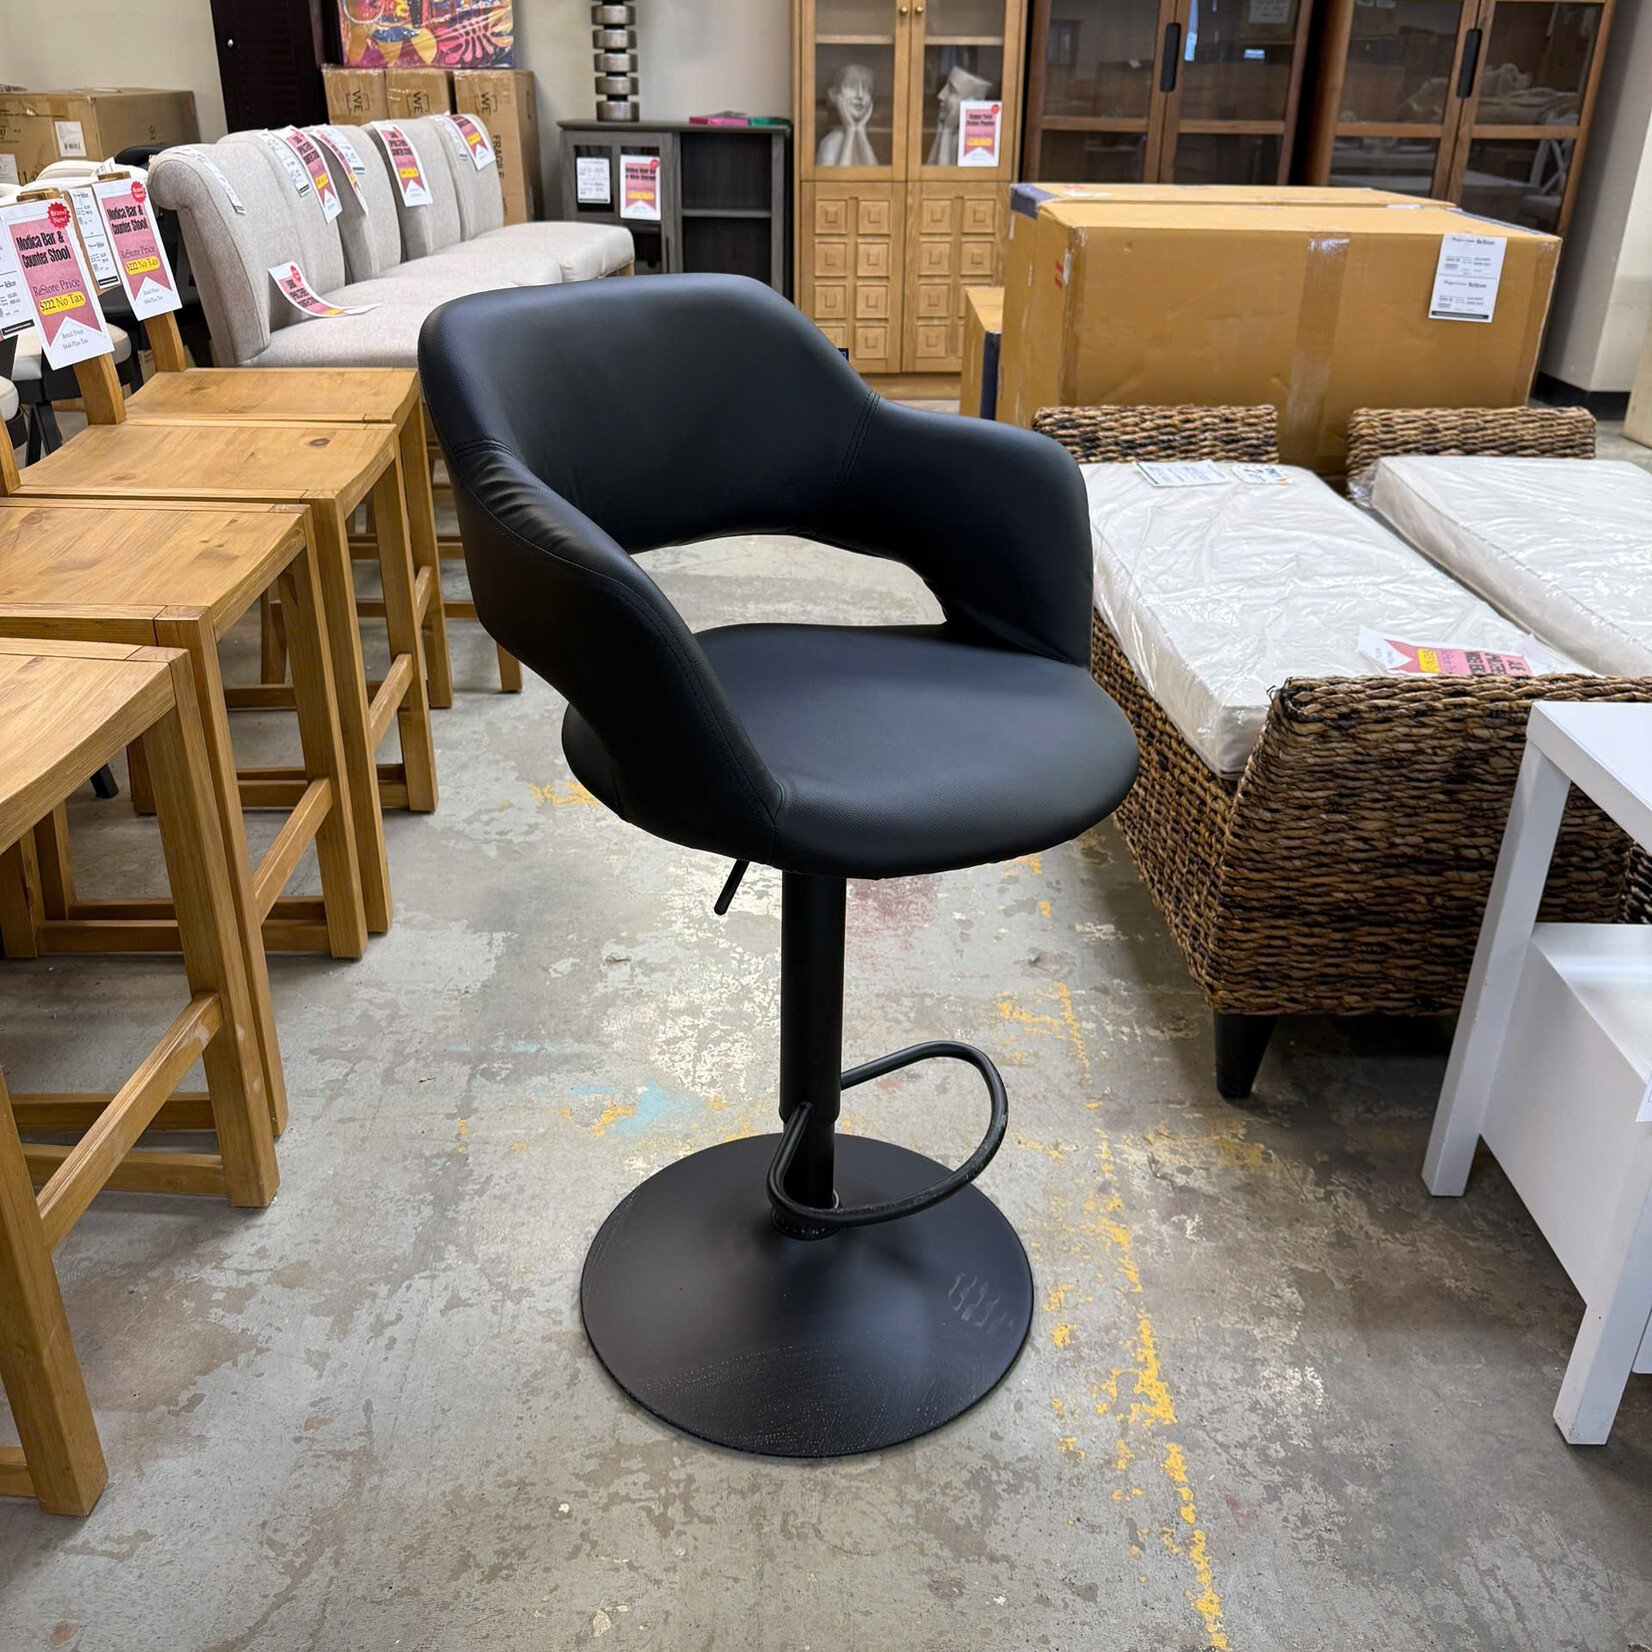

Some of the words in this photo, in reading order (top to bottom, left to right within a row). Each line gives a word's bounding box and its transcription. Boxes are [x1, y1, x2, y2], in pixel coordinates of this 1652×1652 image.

[351, 89, 364, 113] WE
[412, 90, 424, 114] WE
[480, 91, 492, 115] WE
[125, 206, 137, 217] Bar
[40, 232, 56, 246] Bar
[57, 230, 65, 243] &
[22, 251, 49, 268] Counter
[48, 245, 71, 262] Stool
[137, 260, 147, 269] No
[146, 258, 158, 266] Tax
[33, 283, 59, 297] ReStore
[59, 279, 80, 291] Price
[40, 299, 56, 312] $222
[56, 297, 68, 307] No
[68, 294, 84, 304] Tax
